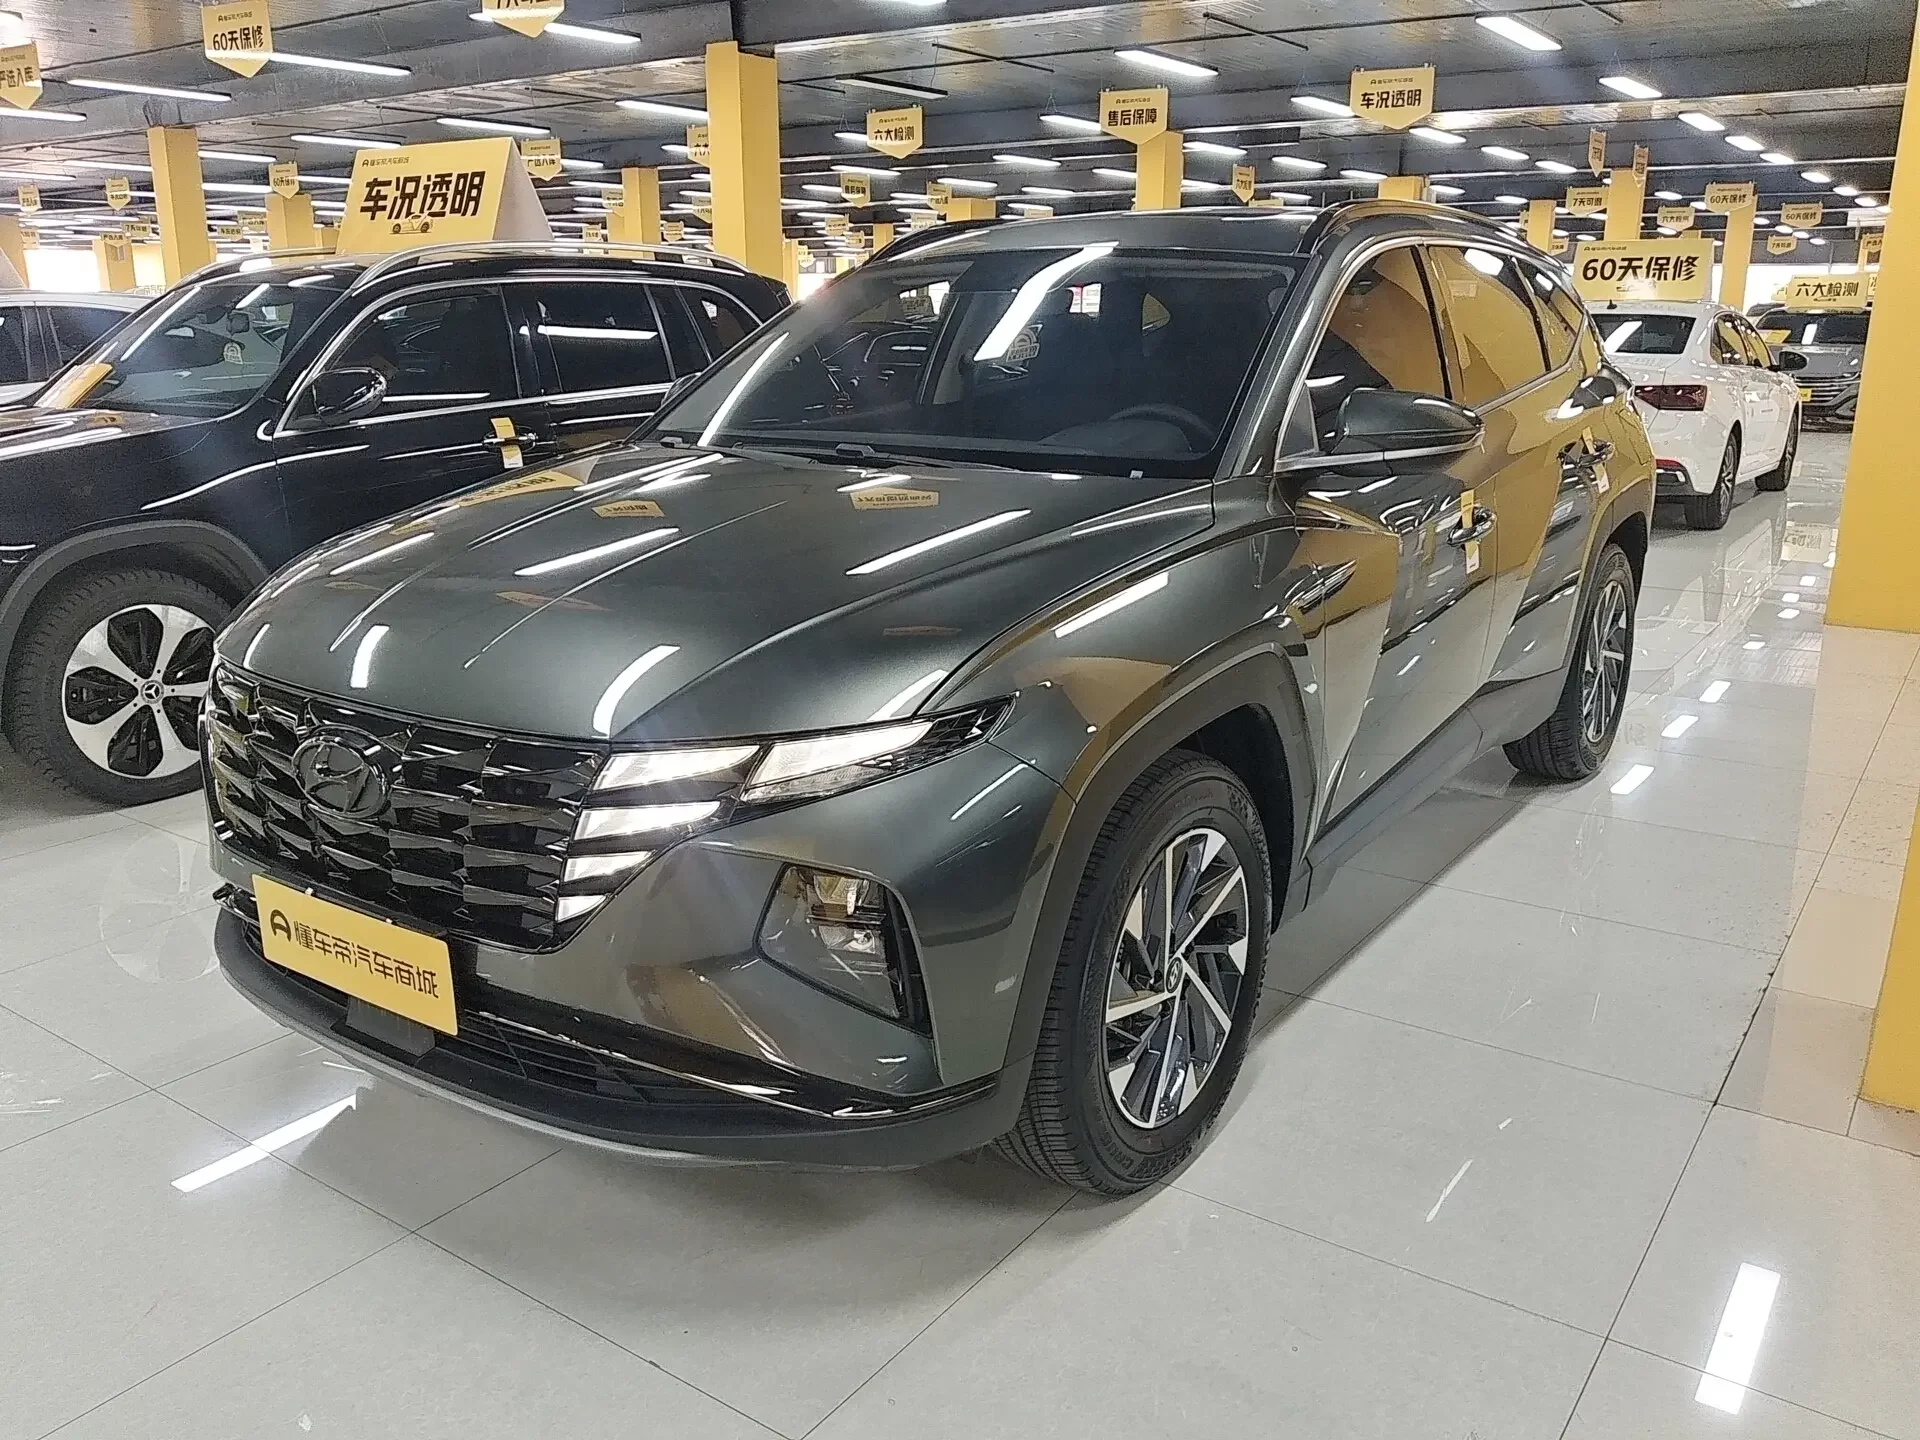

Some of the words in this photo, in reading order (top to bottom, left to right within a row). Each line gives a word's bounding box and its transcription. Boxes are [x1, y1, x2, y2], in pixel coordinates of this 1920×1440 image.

[213, 25, 264, 51] 60天保修
[1360, 88, 1422, 109] 车况透明
[1107, 107, 1157, 127] 售后保障
[873, 125, 915, 141] 六大检测
[360, 170, 486, 221] 车况透明
[1709, 193, 1748, 204] 60天保修
[1582, 255, 1700, 282] 60天保修
[1795, 281, 1860, 297] 六大检测
[292, 919, 440, 1000] 懂车帝汽车商城
